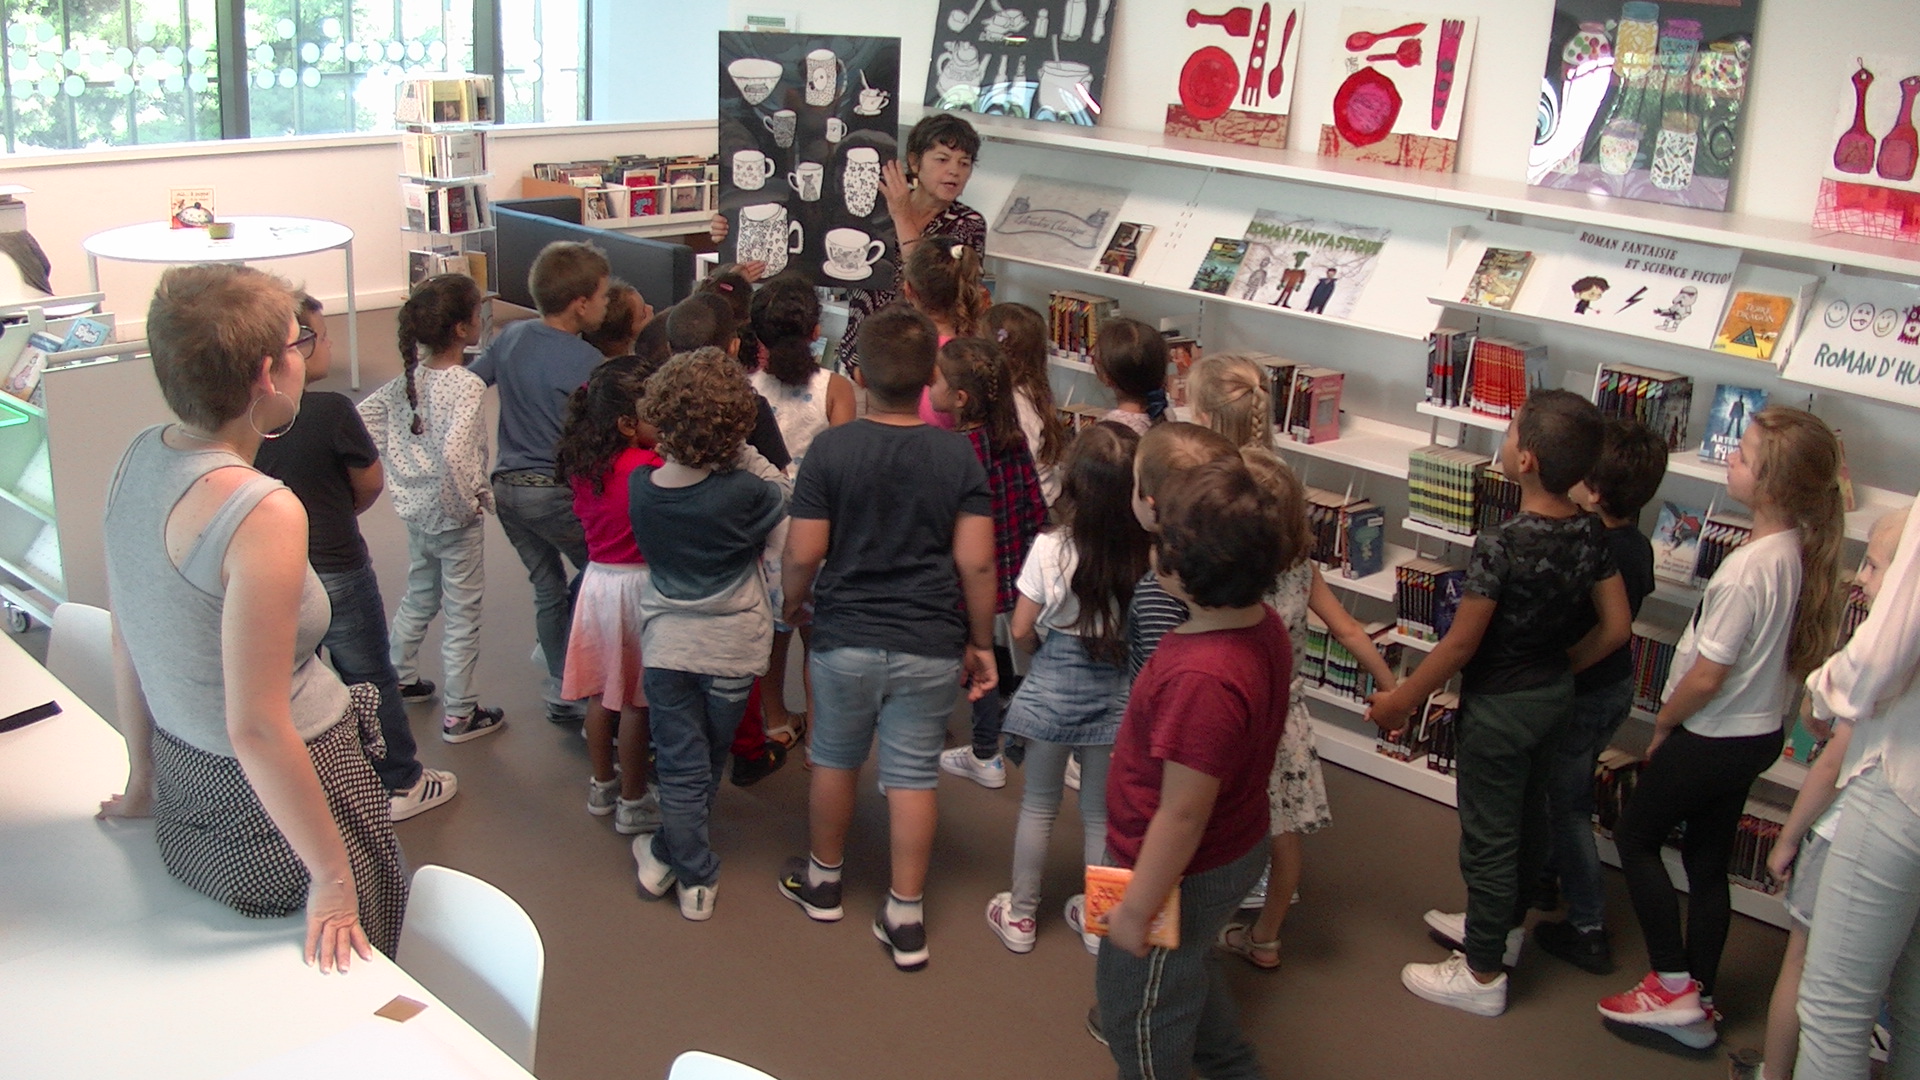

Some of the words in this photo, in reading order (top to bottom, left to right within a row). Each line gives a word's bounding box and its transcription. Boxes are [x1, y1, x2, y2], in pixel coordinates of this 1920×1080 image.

[1579, 231, 1619, 250] ROMAN
[1621, 241, 1679, 261] FANTAISIE
[1625, 258, 1640, 270] ET
[1642, 261, 1688, 279] SCIENCE
